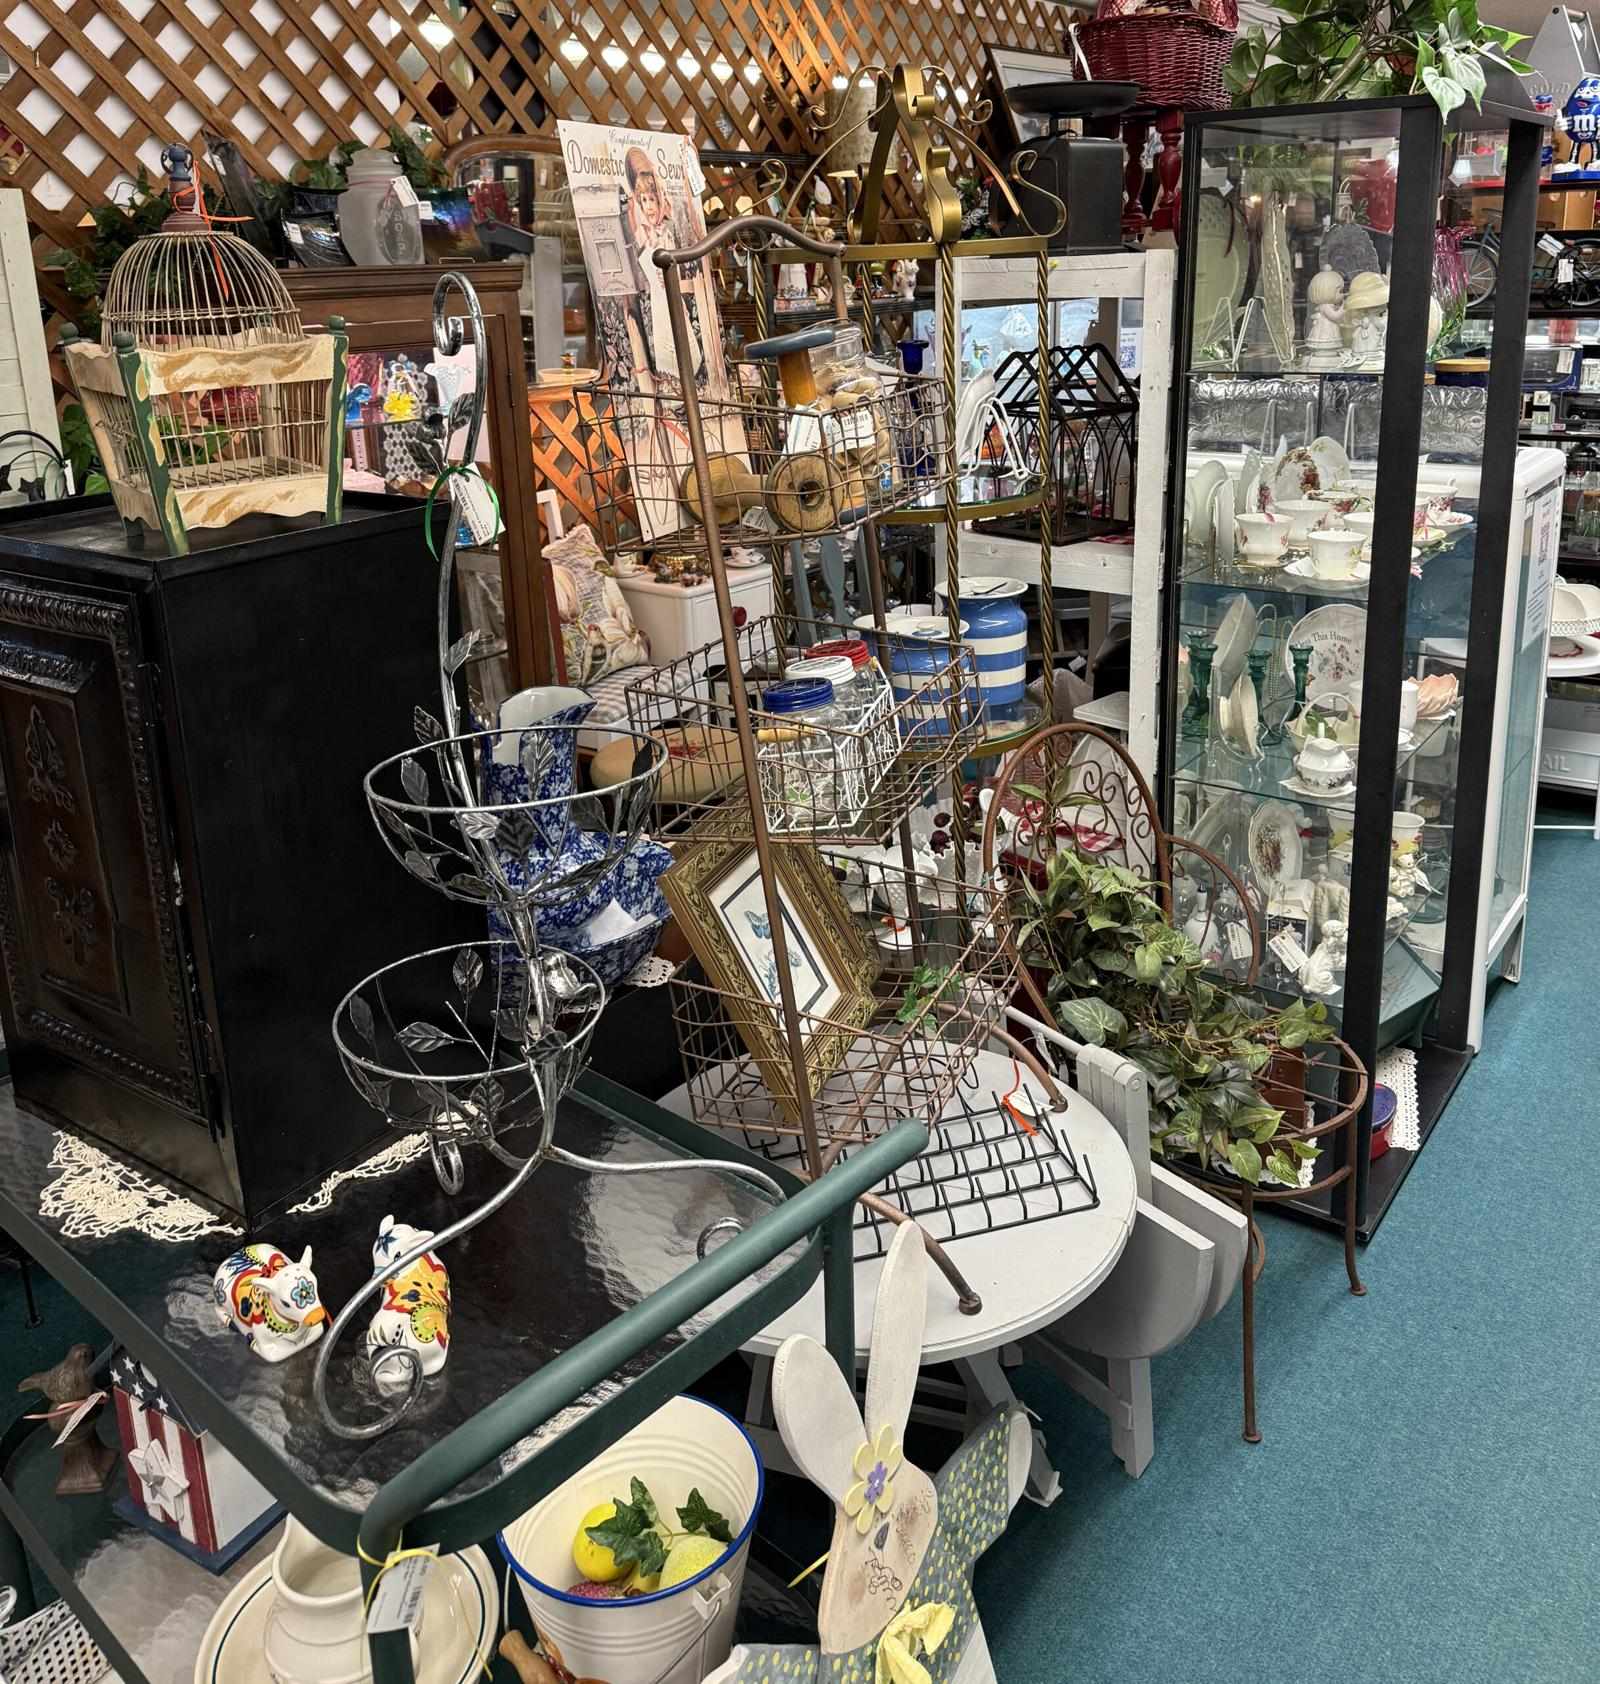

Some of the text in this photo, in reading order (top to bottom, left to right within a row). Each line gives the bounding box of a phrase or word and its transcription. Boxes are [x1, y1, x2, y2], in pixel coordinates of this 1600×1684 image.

[567, 138, 625, 178] Domestic
[656, 147, 687, 181] Sewi
[1542, 752, 1571, 772] AIL
